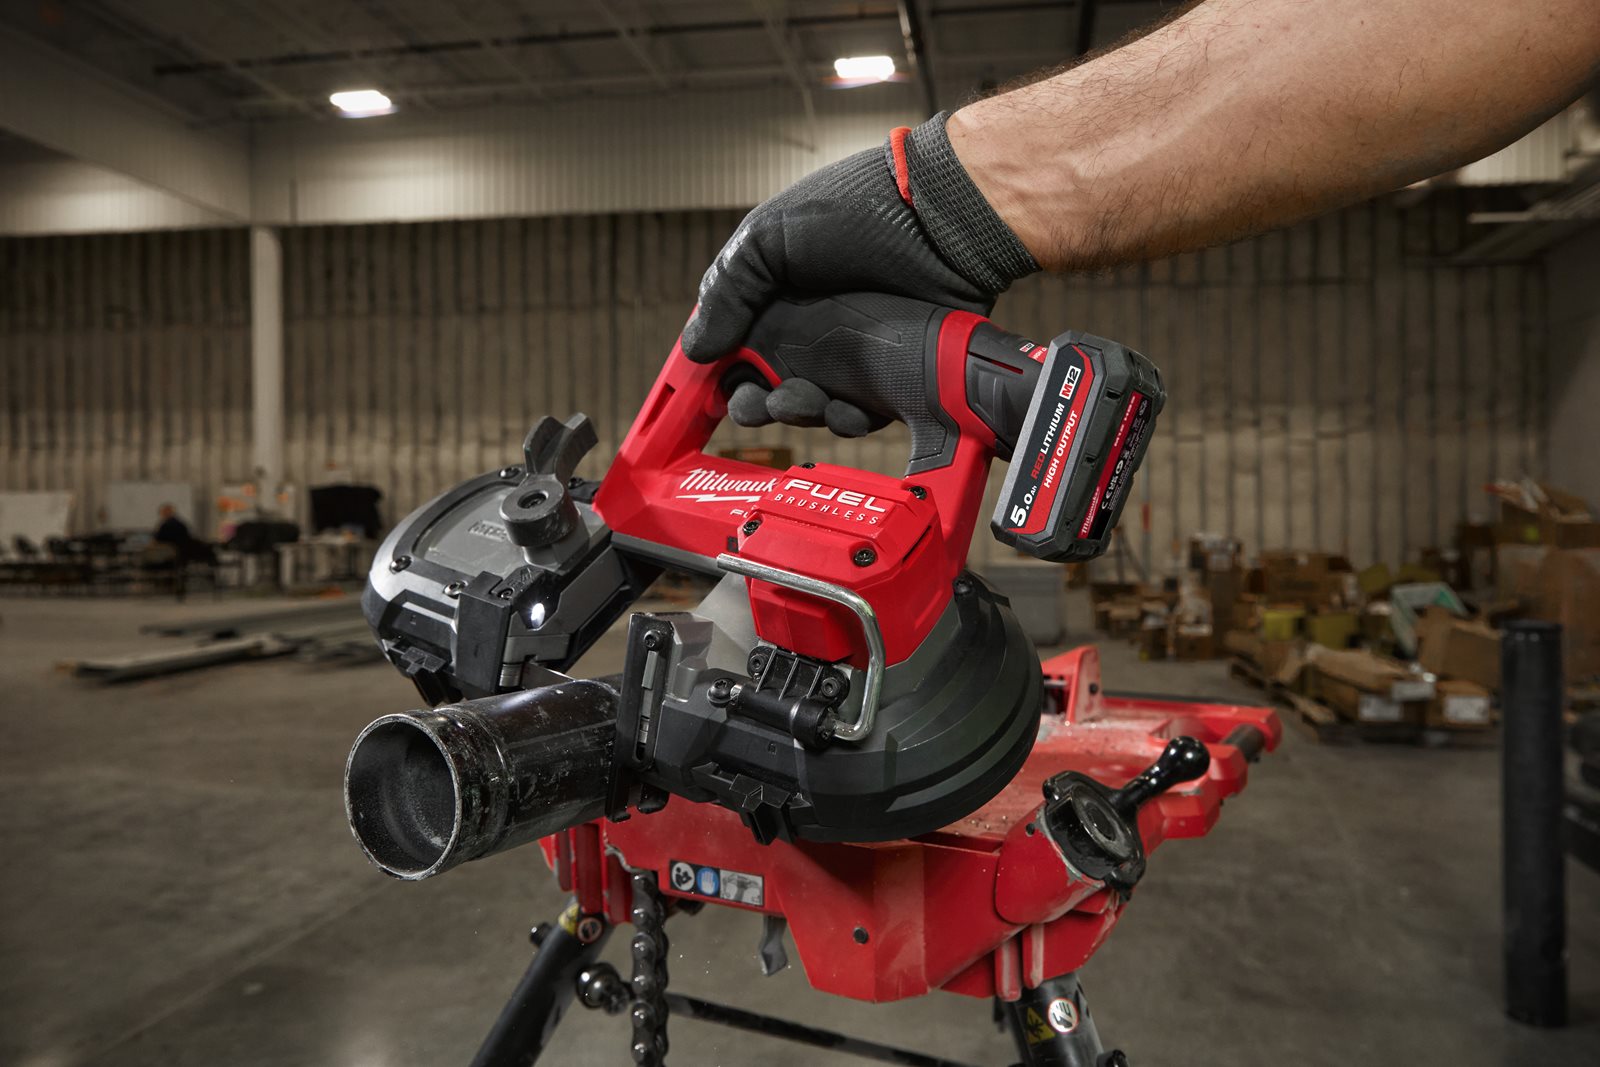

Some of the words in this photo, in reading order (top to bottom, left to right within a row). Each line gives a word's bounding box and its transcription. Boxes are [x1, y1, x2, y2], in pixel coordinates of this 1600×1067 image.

[1061, 367, 1079, 398] M12
[1044, 458, 1060, 488] HIGH
[1056, 410, 1078, 457] OUTPUT
[680, 468, 779, 492] Milwauk
[774, 493, 878, 524] BRUSHLESS
[784, 479, 886, 513] FUEL
